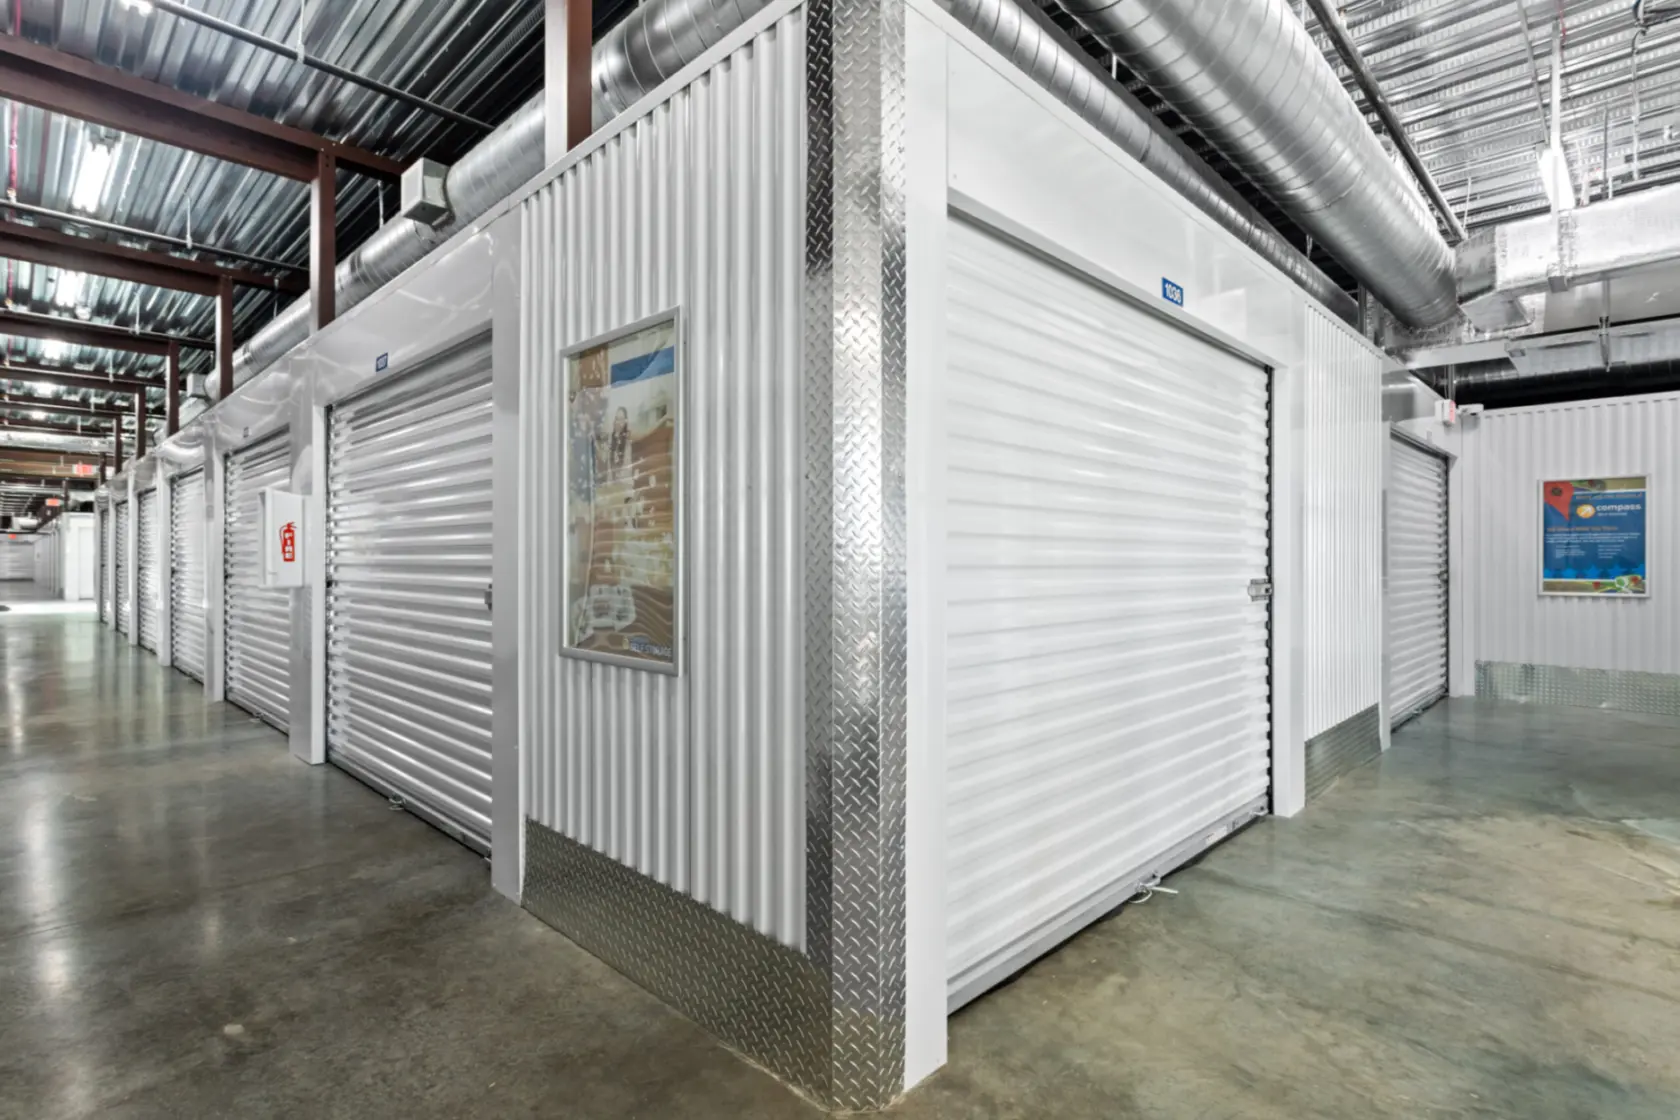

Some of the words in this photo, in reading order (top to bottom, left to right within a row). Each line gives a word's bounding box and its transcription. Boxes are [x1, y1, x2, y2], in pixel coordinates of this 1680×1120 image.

[1165, 282, 1181, 303] 1036
[1596, 503, 1641, 513] compass
[284, 532, 294, 559] FIRE
